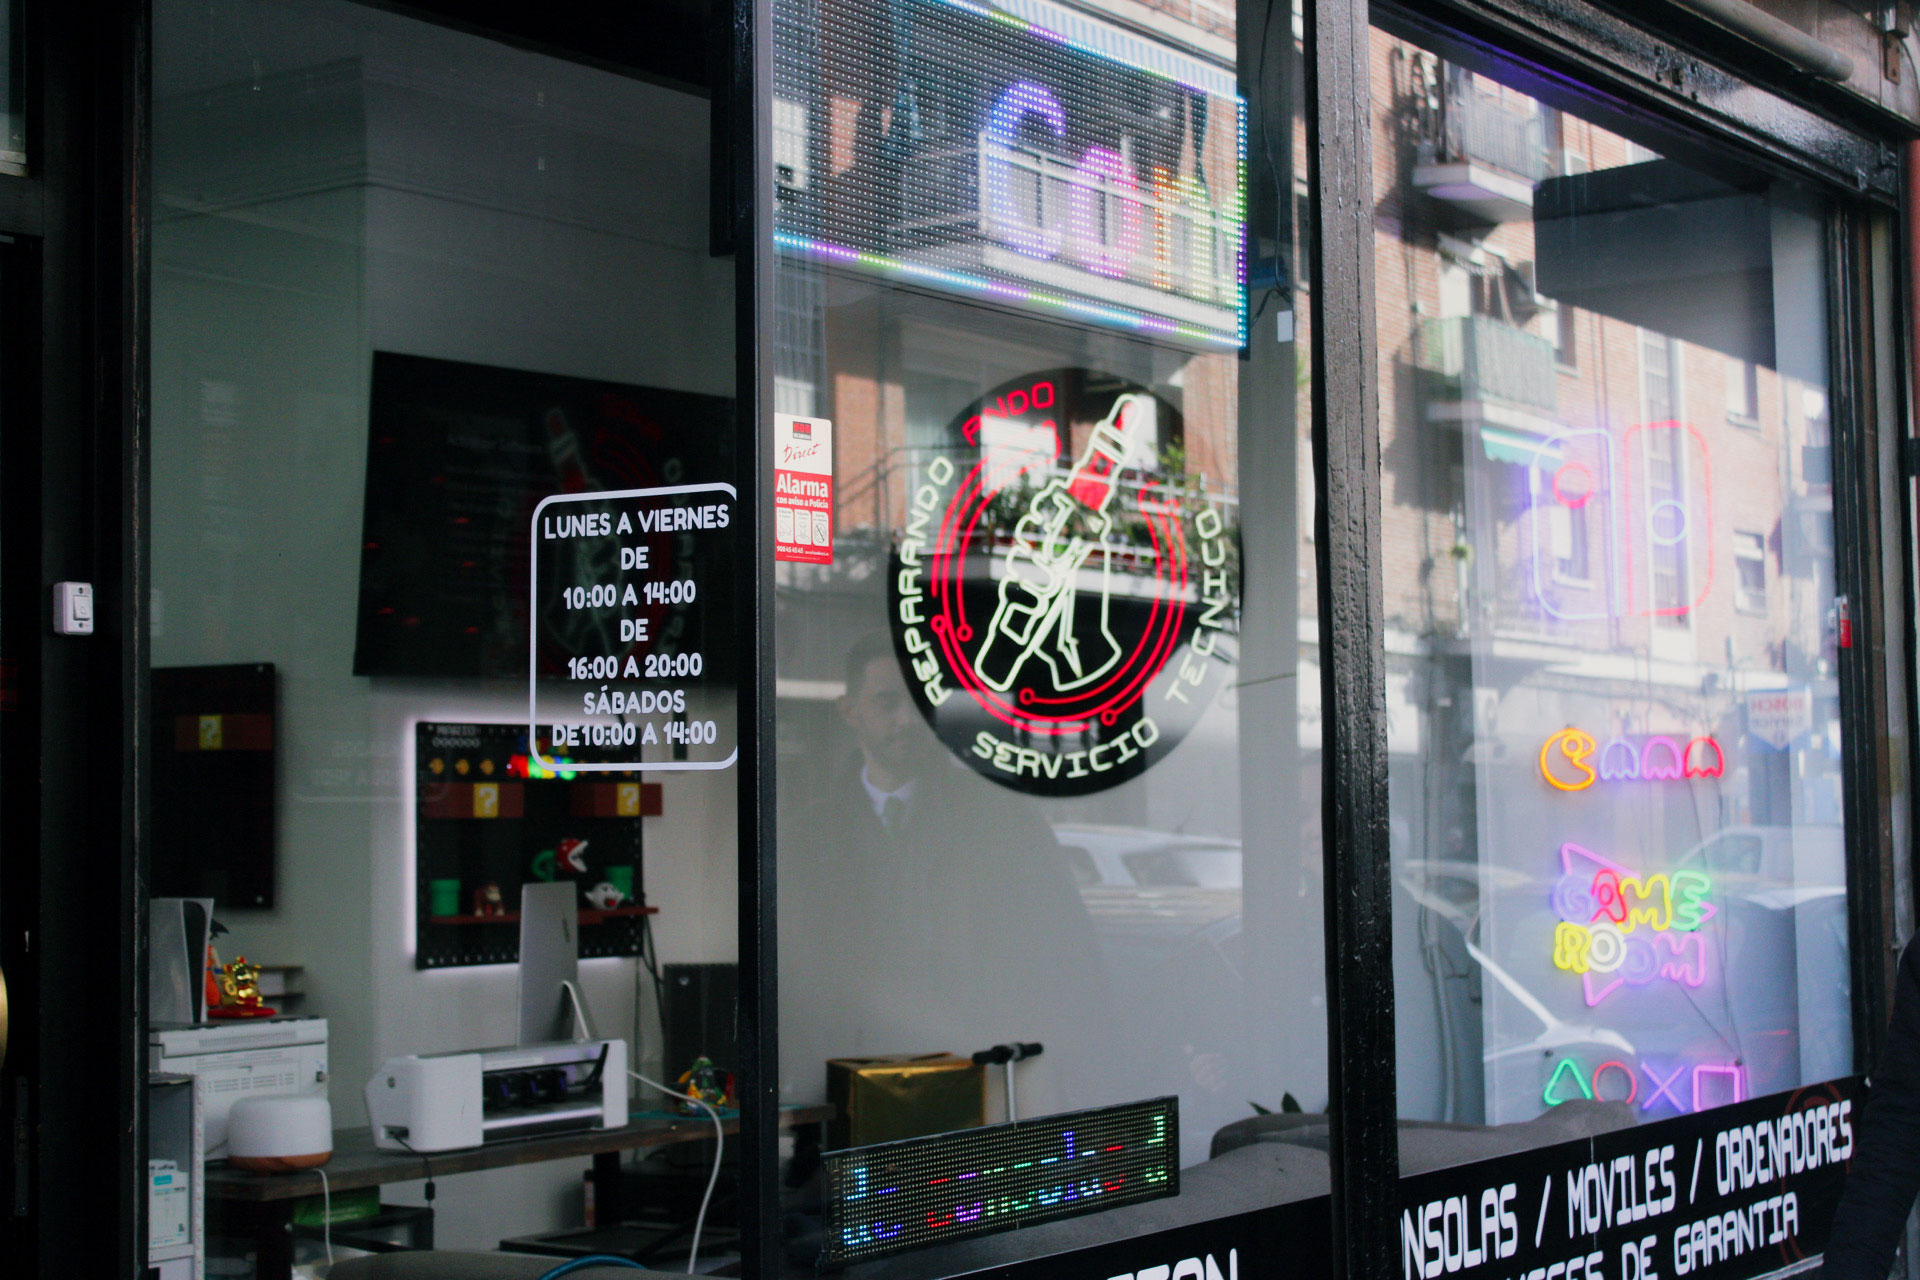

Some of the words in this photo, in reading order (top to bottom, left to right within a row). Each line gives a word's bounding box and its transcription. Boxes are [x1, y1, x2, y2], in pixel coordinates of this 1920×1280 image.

[776, 473, 829, 498] Alarma
[776, 496, 788, 505] con
[788, 496, 804, 506] aviso
[809, 498, 829, 509] Policía
[544, 512, 611, 539] LUNES
[616, 511, 633, 535] A
[637, 504, 730, 533] VIERNES
[620, 546, 649, 570] DE
[563, 583, 617, 610] 10:00
[621, 583, 638, 606] A
[643, 579, 696, 605] 14:00
[898, 456, 954, 707] REPARANDO
[1164, 508, 1227, 704] TECNICO
[620, 618, 649, 642] DE
[567, 655, 619, 680] 16:00
[623, 655, 640, 678] A
[644, 652, 703, 678] 20:00
[583, 684, 686, 715] SÁBADOS
[641, 721, 658, 745] A
[663, 720, 717, 745] 14:00
[972, 716, 1160, 779] SERVICIO
[1552, 868, 1712, 934] GAME
[1552, 921, 1708, 988] ROOM
[1400, 1183, 1519, 1280] NSOLAS
[1567, 1144, 1676, 1239] MOVILES
[1715, 1099, 1853, 1197] ORDENADORES
[1621, 1234, 1659, 1280] DE
[1673, 1191, 1799, 1276] GARANTIA
